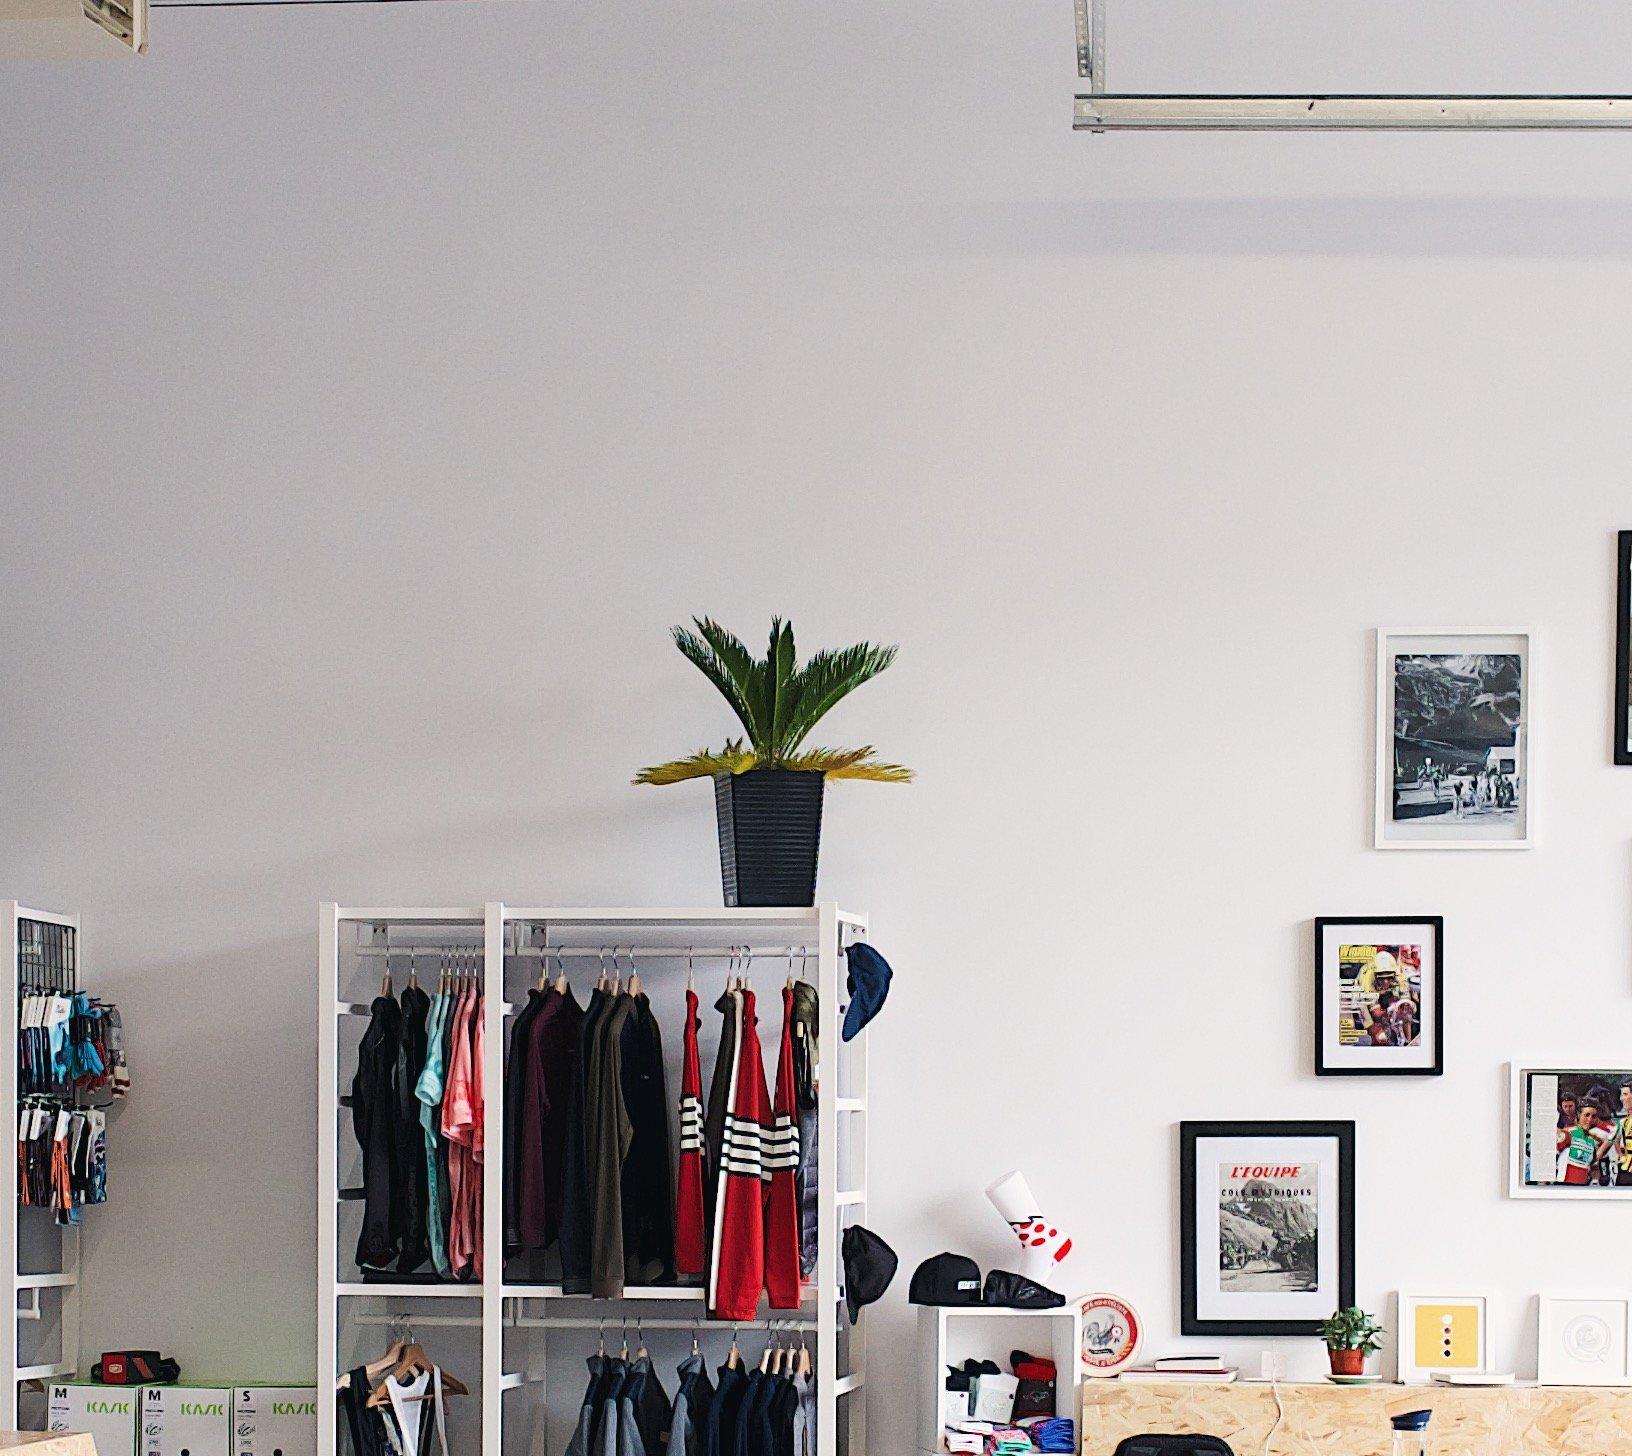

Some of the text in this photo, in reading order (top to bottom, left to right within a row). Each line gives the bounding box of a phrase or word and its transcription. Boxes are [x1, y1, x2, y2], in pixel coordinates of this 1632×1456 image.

[55, 1388, 67, 1398] M
[149, 1390, 161, 1401] M
[243, 1391, 250, 1401] S
[181, 1403, 223, 1416] KASK
